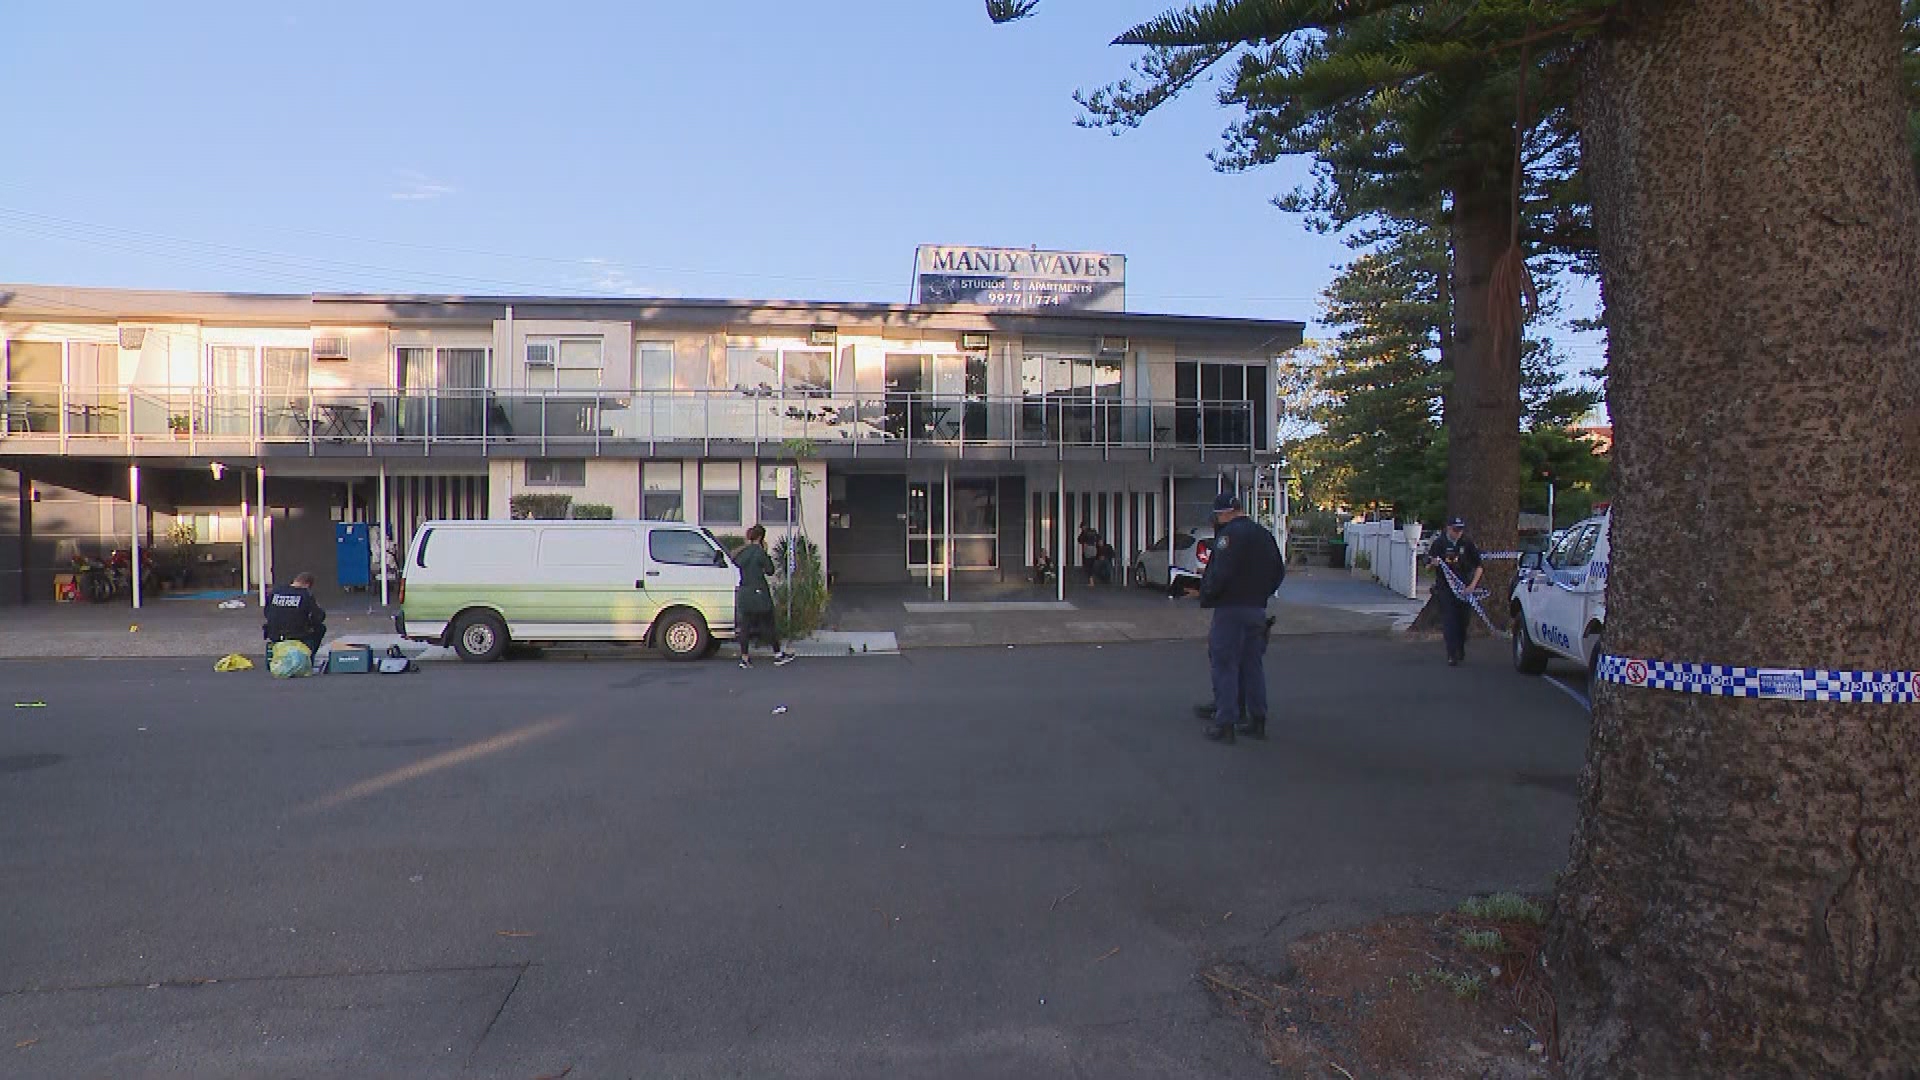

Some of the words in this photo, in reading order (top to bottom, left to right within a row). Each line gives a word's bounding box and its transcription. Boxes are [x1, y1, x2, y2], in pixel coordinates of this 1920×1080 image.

[933, 249, 1022, 272] MANLY
[1029, 253, 1110, 277] WAVES
[961, 279, 1005, 289] STUDIOS
[1029, 281, 1093, 293] APARTMENTS
[988, 293, 1021, 305] 9977
[1028, 294, 1060, 305] 1774
[1541, 623, 1571, 649] Police
